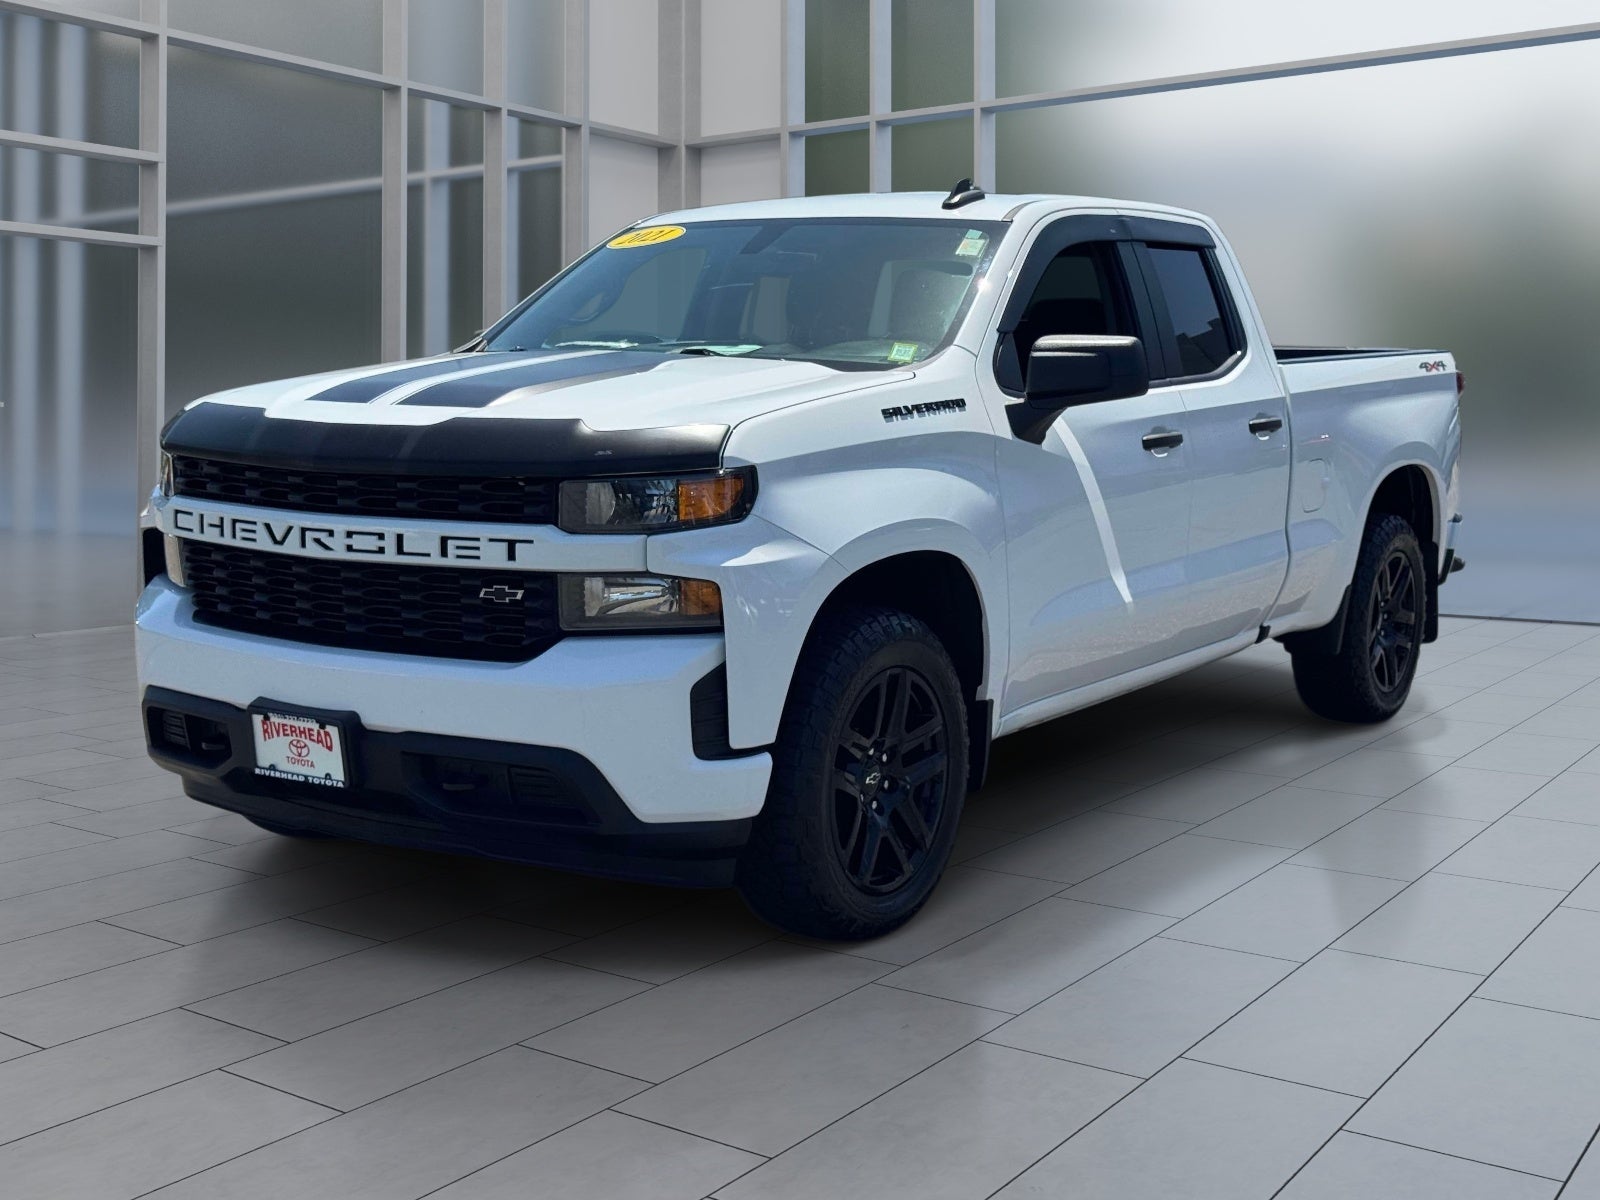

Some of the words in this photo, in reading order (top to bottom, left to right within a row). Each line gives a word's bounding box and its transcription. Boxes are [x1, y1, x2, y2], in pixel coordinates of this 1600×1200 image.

[613, 228, 676, 246] 2021
[881, 398, 967, 419] SILVERADO
[174, 509, 534, 562] CHEVROLET
[261, 719, 334, 752] RIVERHEAD
[286, 756, 316, 769] TOYOTA
[255, 767, 306, 782] RIVERHEAD
[308, 776, 345, 788] TOYOTA
